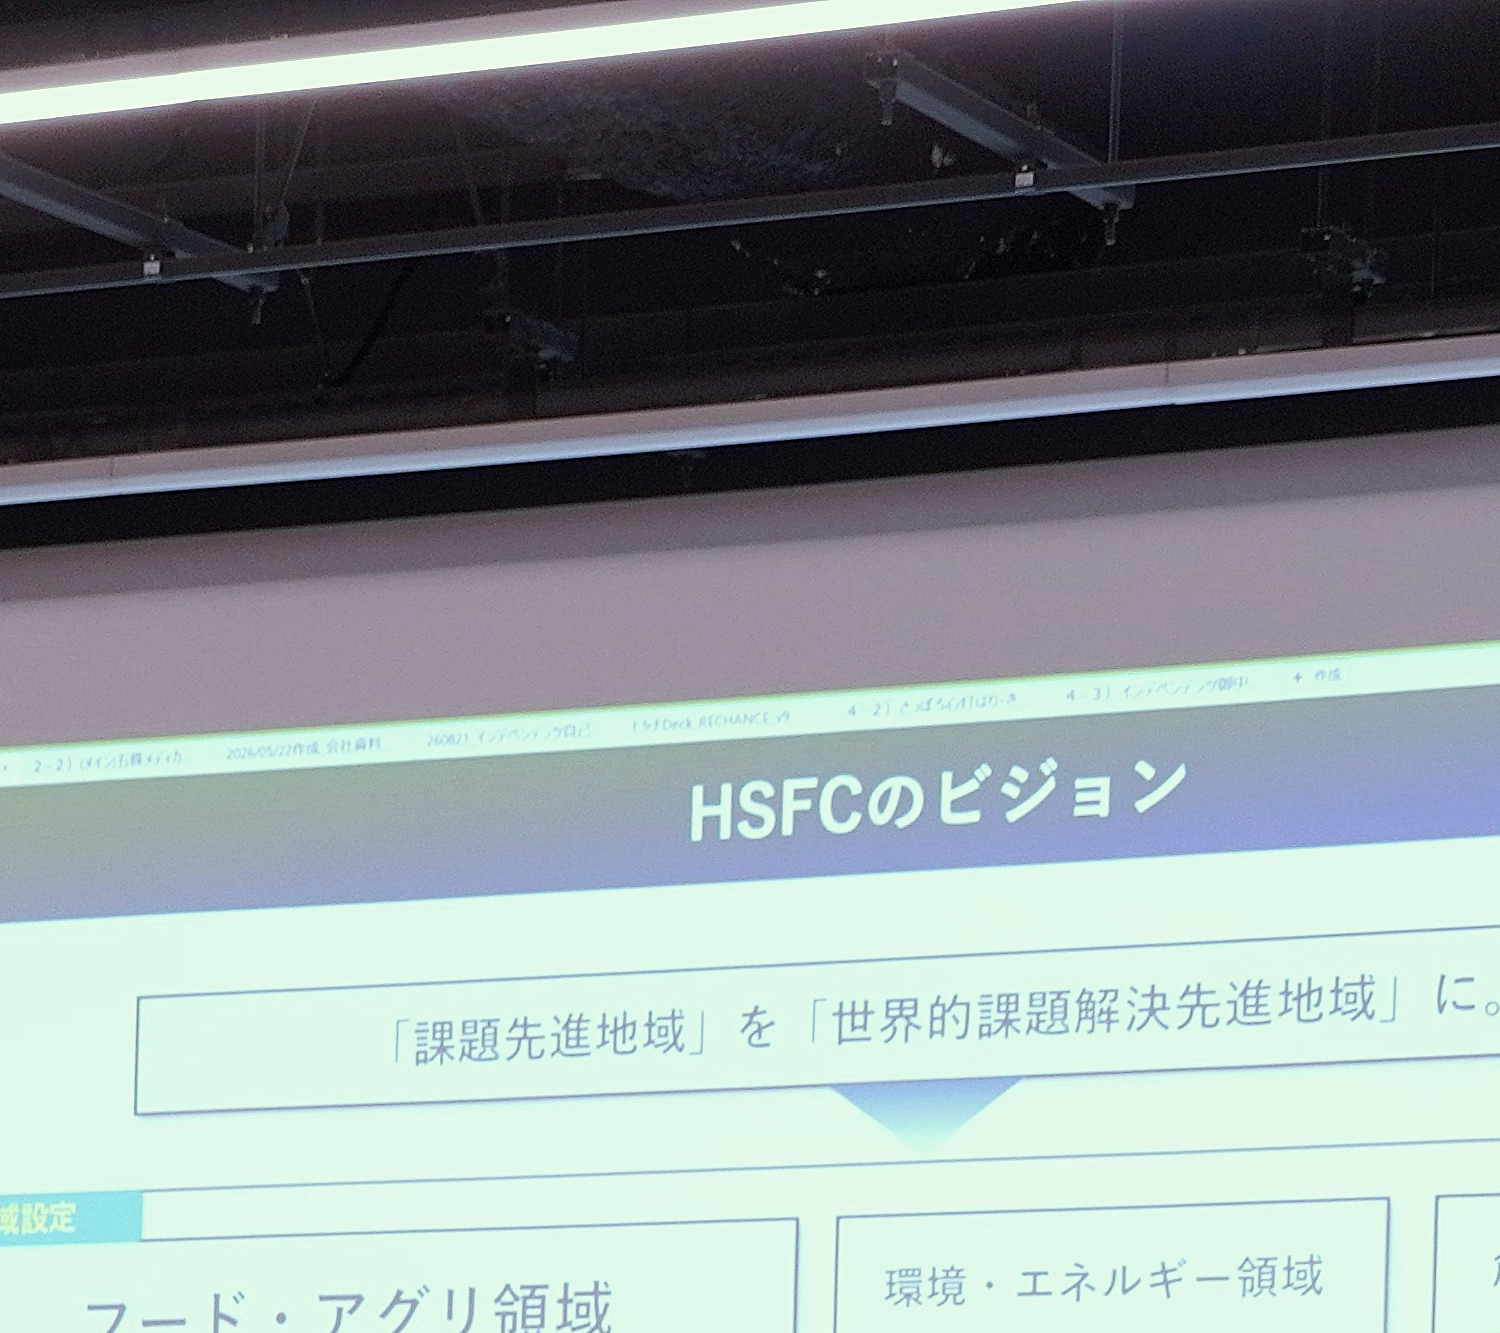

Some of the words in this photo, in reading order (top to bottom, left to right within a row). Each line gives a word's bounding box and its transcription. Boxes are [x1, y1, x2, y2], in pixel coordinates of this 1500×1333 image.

[689, 757, 1188, 842] HSFCのビジョン
[884, 1254, 1324, 1308] 環境・エネルギー領域
